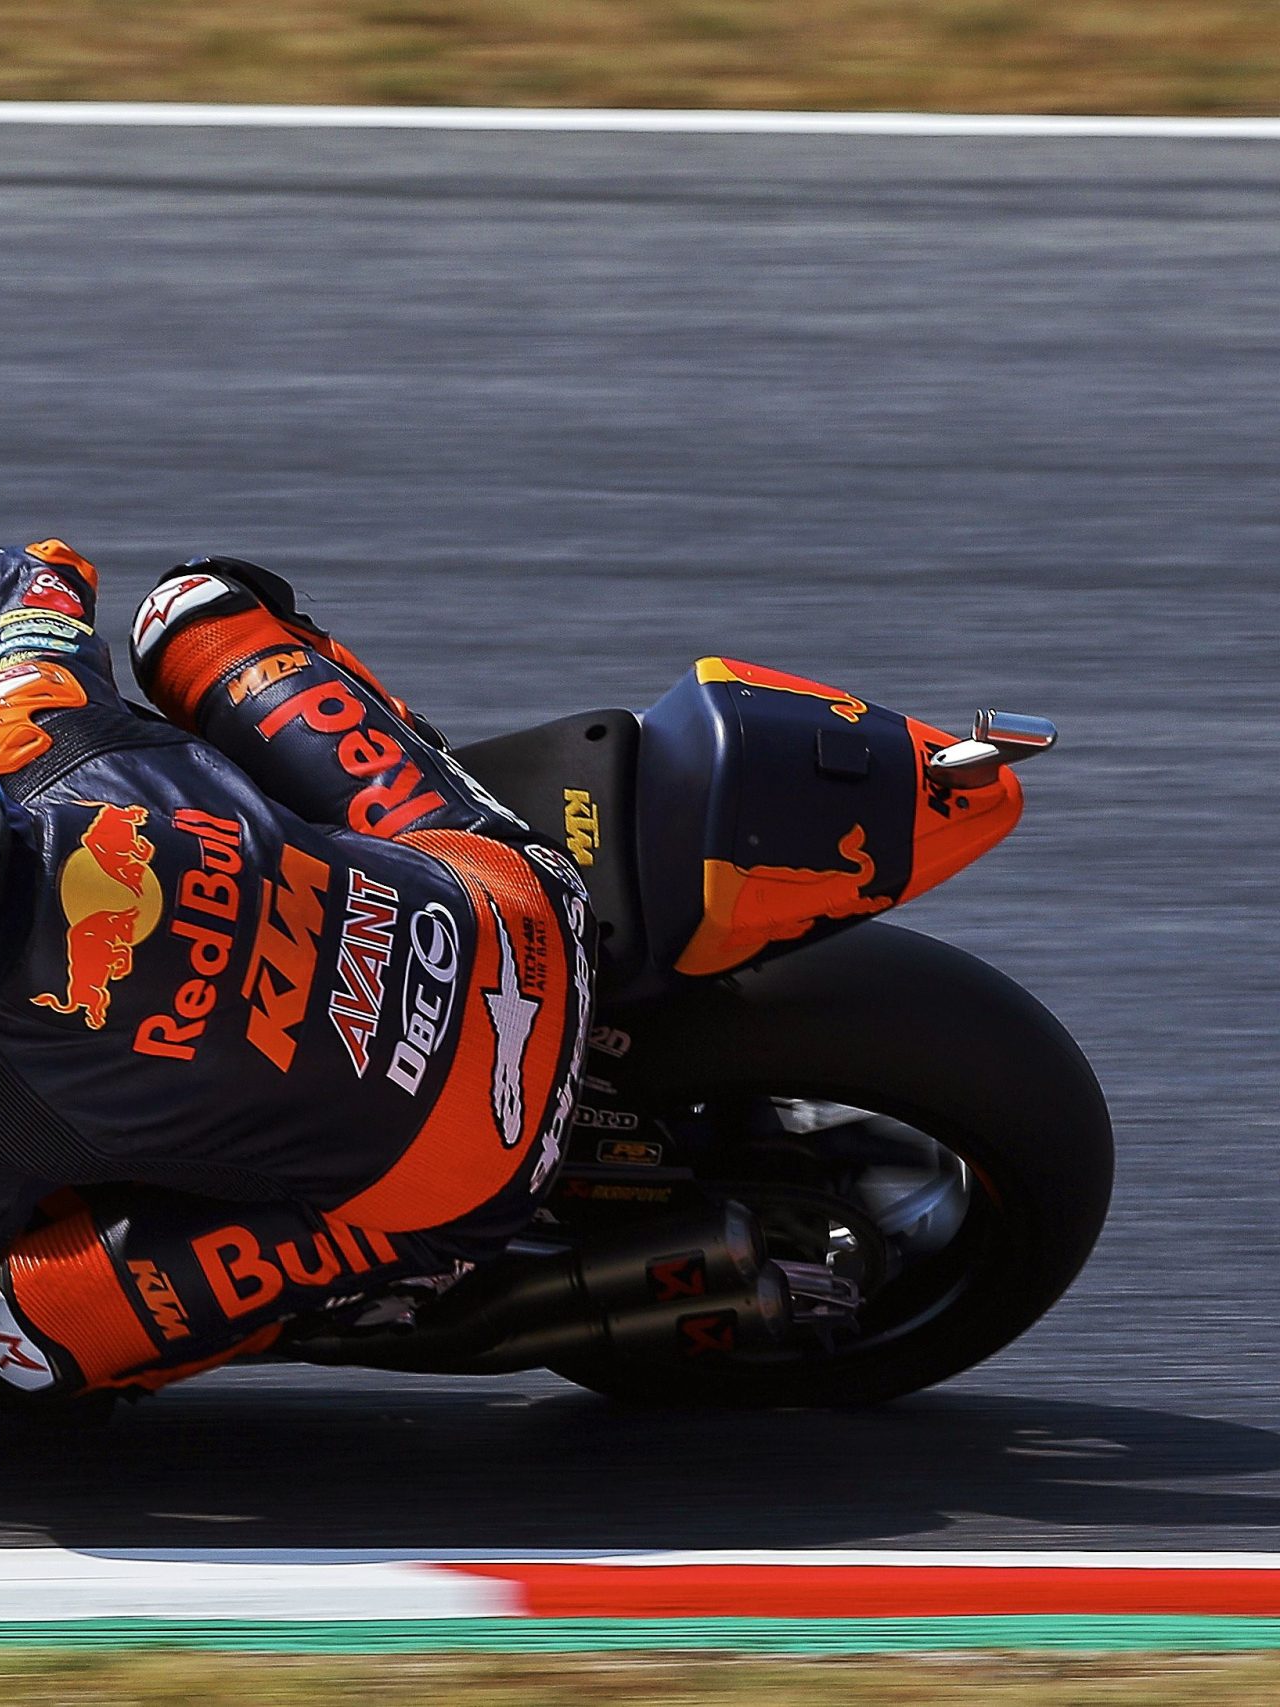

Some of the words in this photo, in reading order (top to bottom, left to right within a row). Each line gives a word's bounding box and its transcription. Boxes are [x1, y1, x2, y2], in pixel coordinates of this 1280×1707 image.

[226, 651, 311, 707] KTM
[256, 680, 448, 839] Red
[173, 808, 244, 922] Bull
[564, 788, 601, 867] KTM
[133, 920, 233, 1061] Red
[241, 843, 331, 1074] KTM
[328, 868, 400, 1078] AVANT
[386, 984, 444, 1097] DBC
[127, 1260, 190, 1341] KTM
[191, 1214, 399, 1320] Bull
